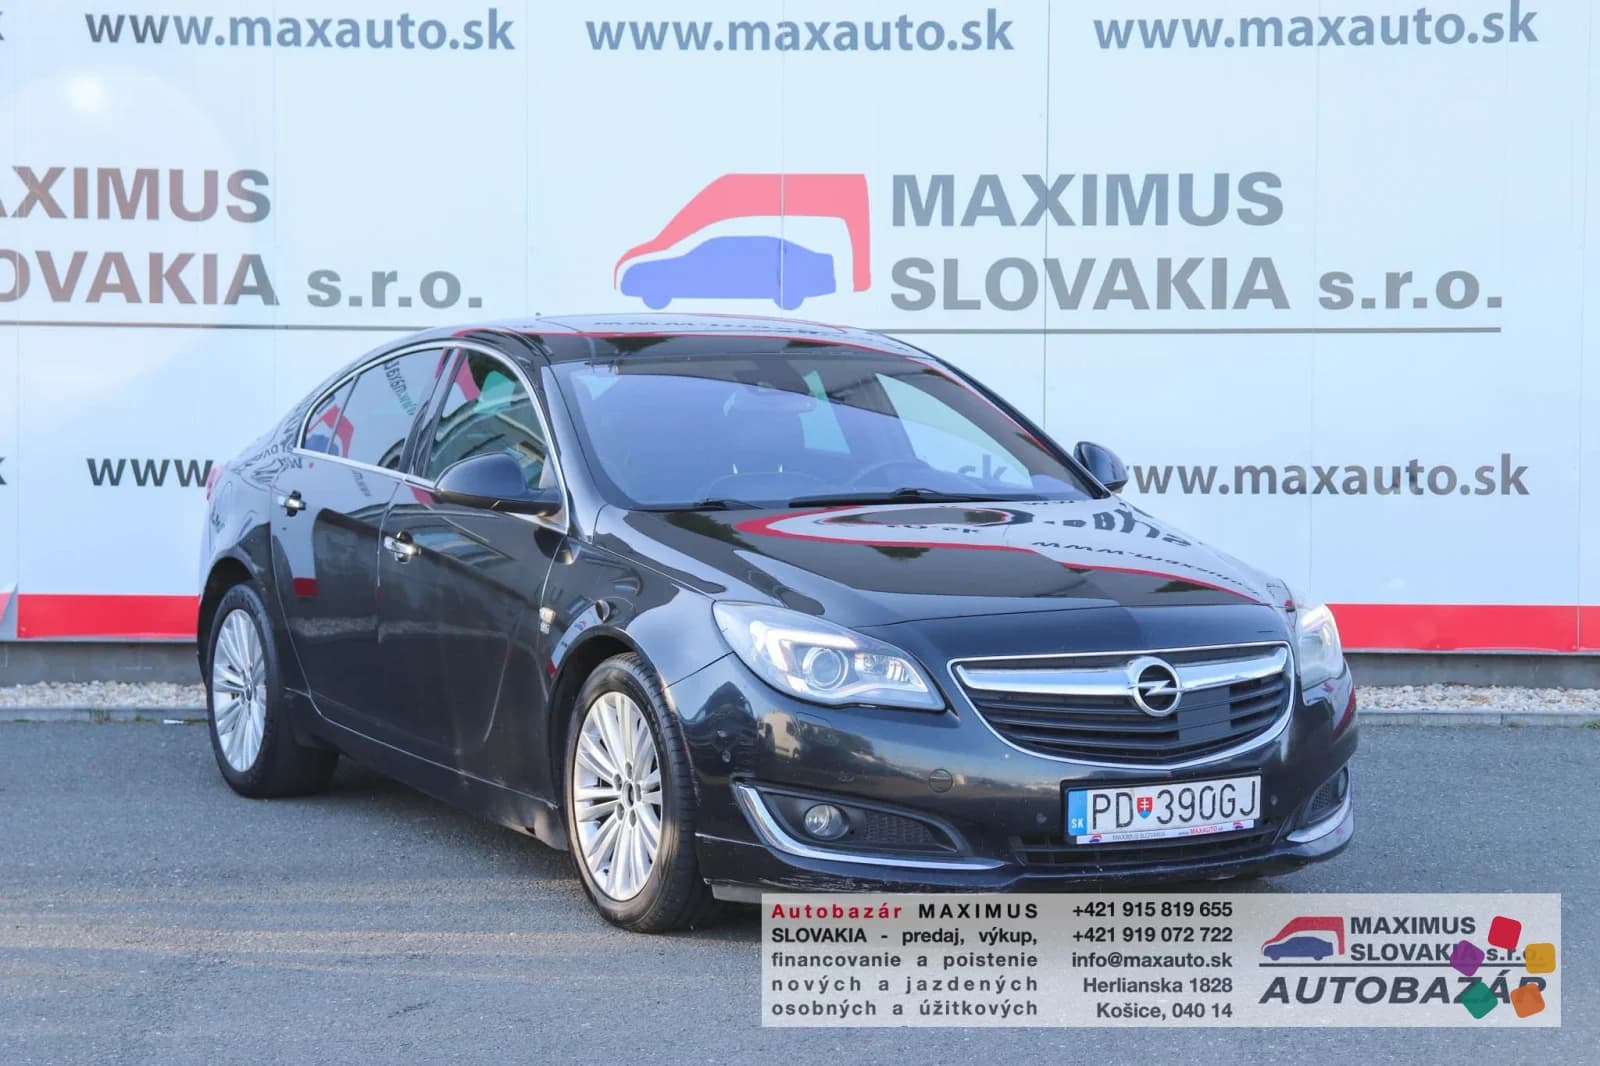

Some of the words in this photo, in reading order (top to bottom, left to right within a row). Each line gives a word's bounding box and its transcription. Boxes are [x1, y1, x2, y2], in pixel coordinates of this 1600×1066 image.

[85, 8, 514, 50] www.maxauto.sk
[586, 8, 1014, 51] www.maxauto.sk
[1094, 4, 1538, 48] www.maxauto.sk
[0, 166, 270, 223] XIMUS
[893, 172, 1283, 227] MAXIMUS
[308, 270, 482, 308] s.r.o.
[891, 257, 1290, 310] SLOVAKIA
[1319, 271, 1502, 310] s.r.o.
[1126, 454, 1529, 495] ww.maxauto.sk
[1093, 792, 1133, 829] PD
[1157, 781, 1256, 824] 390GJ
